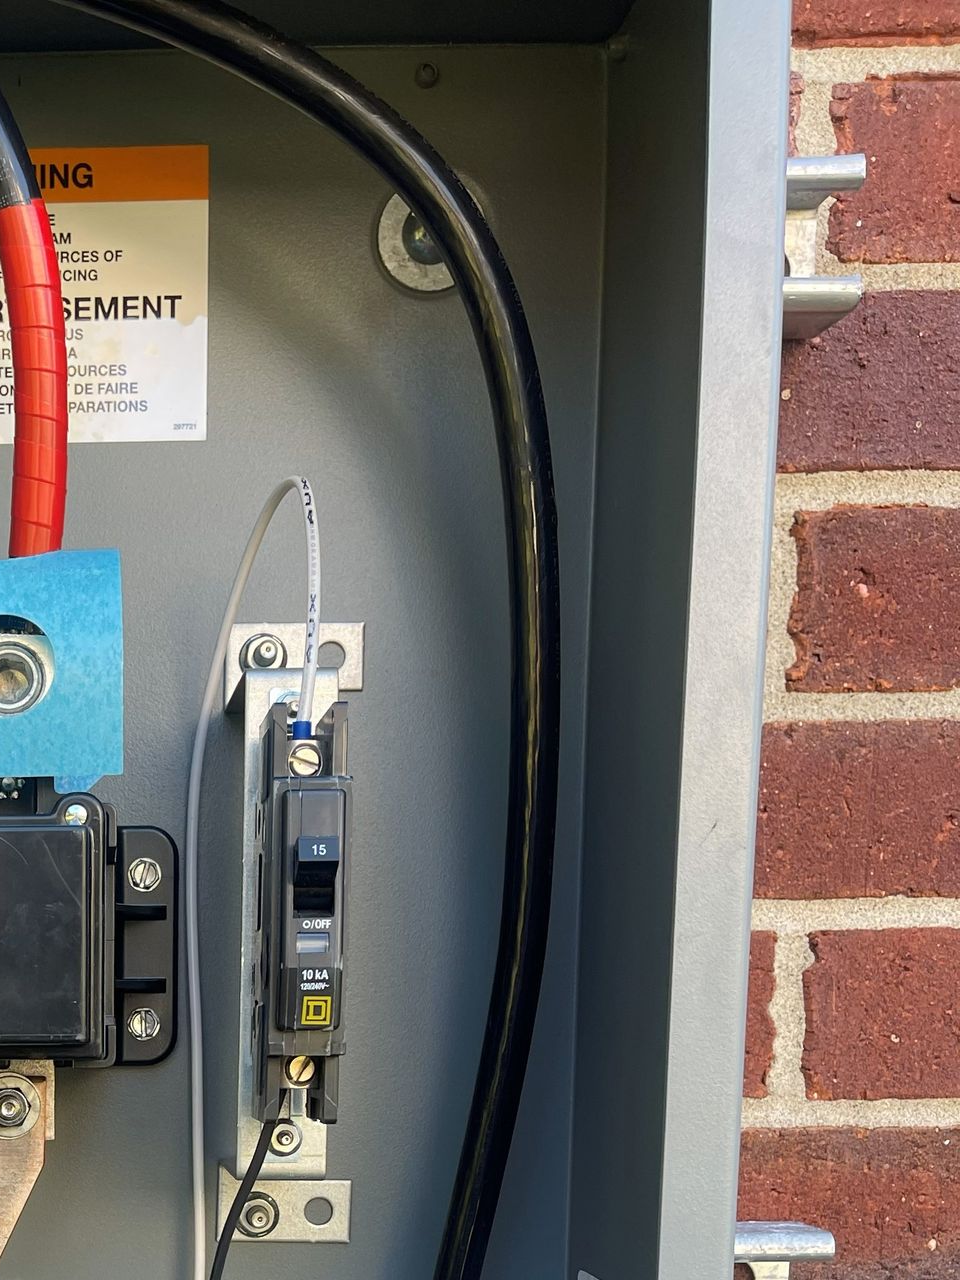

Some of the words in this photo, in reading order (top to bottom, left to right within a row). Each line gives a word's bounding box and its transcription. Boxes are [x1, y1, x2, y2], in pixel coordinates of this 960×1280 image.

[56, 250, 99, 263] RCES
[103, 250, 123, 262] OF
[68, 364, 127, 377] OURCES
[74, 383, 93, 395] DE
[98, 382, 138, 395] FAIRE
[68, 400, 148, 413] PARATIONS
[311, 844, 327, 856] 15
[302, 970, 312, 980] 10
[315, 969, 329, 980] kA
